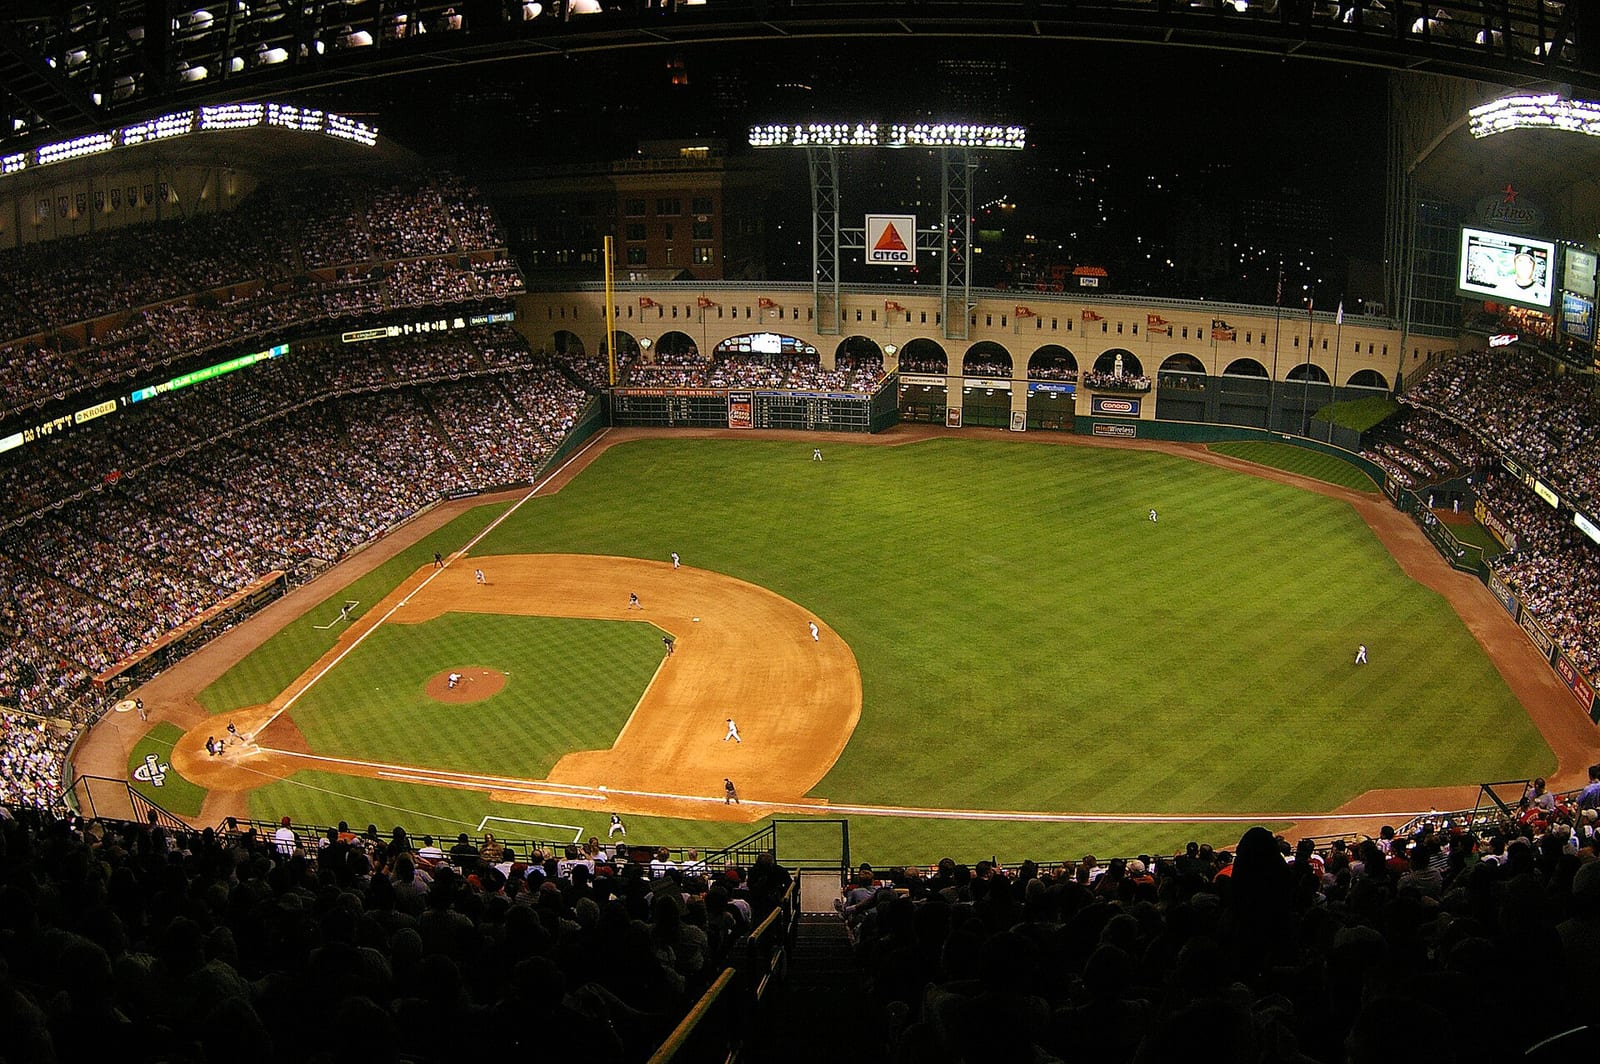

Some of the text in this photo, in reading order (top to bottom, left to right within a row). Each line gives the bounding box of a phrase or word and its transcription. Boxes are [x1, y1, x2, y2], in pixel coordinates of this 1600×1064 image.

[873, 251, 908, 260] CITGO
[83, 402, 114, 418] KROGER
[1491, 577, 1510, 602] CHASE
